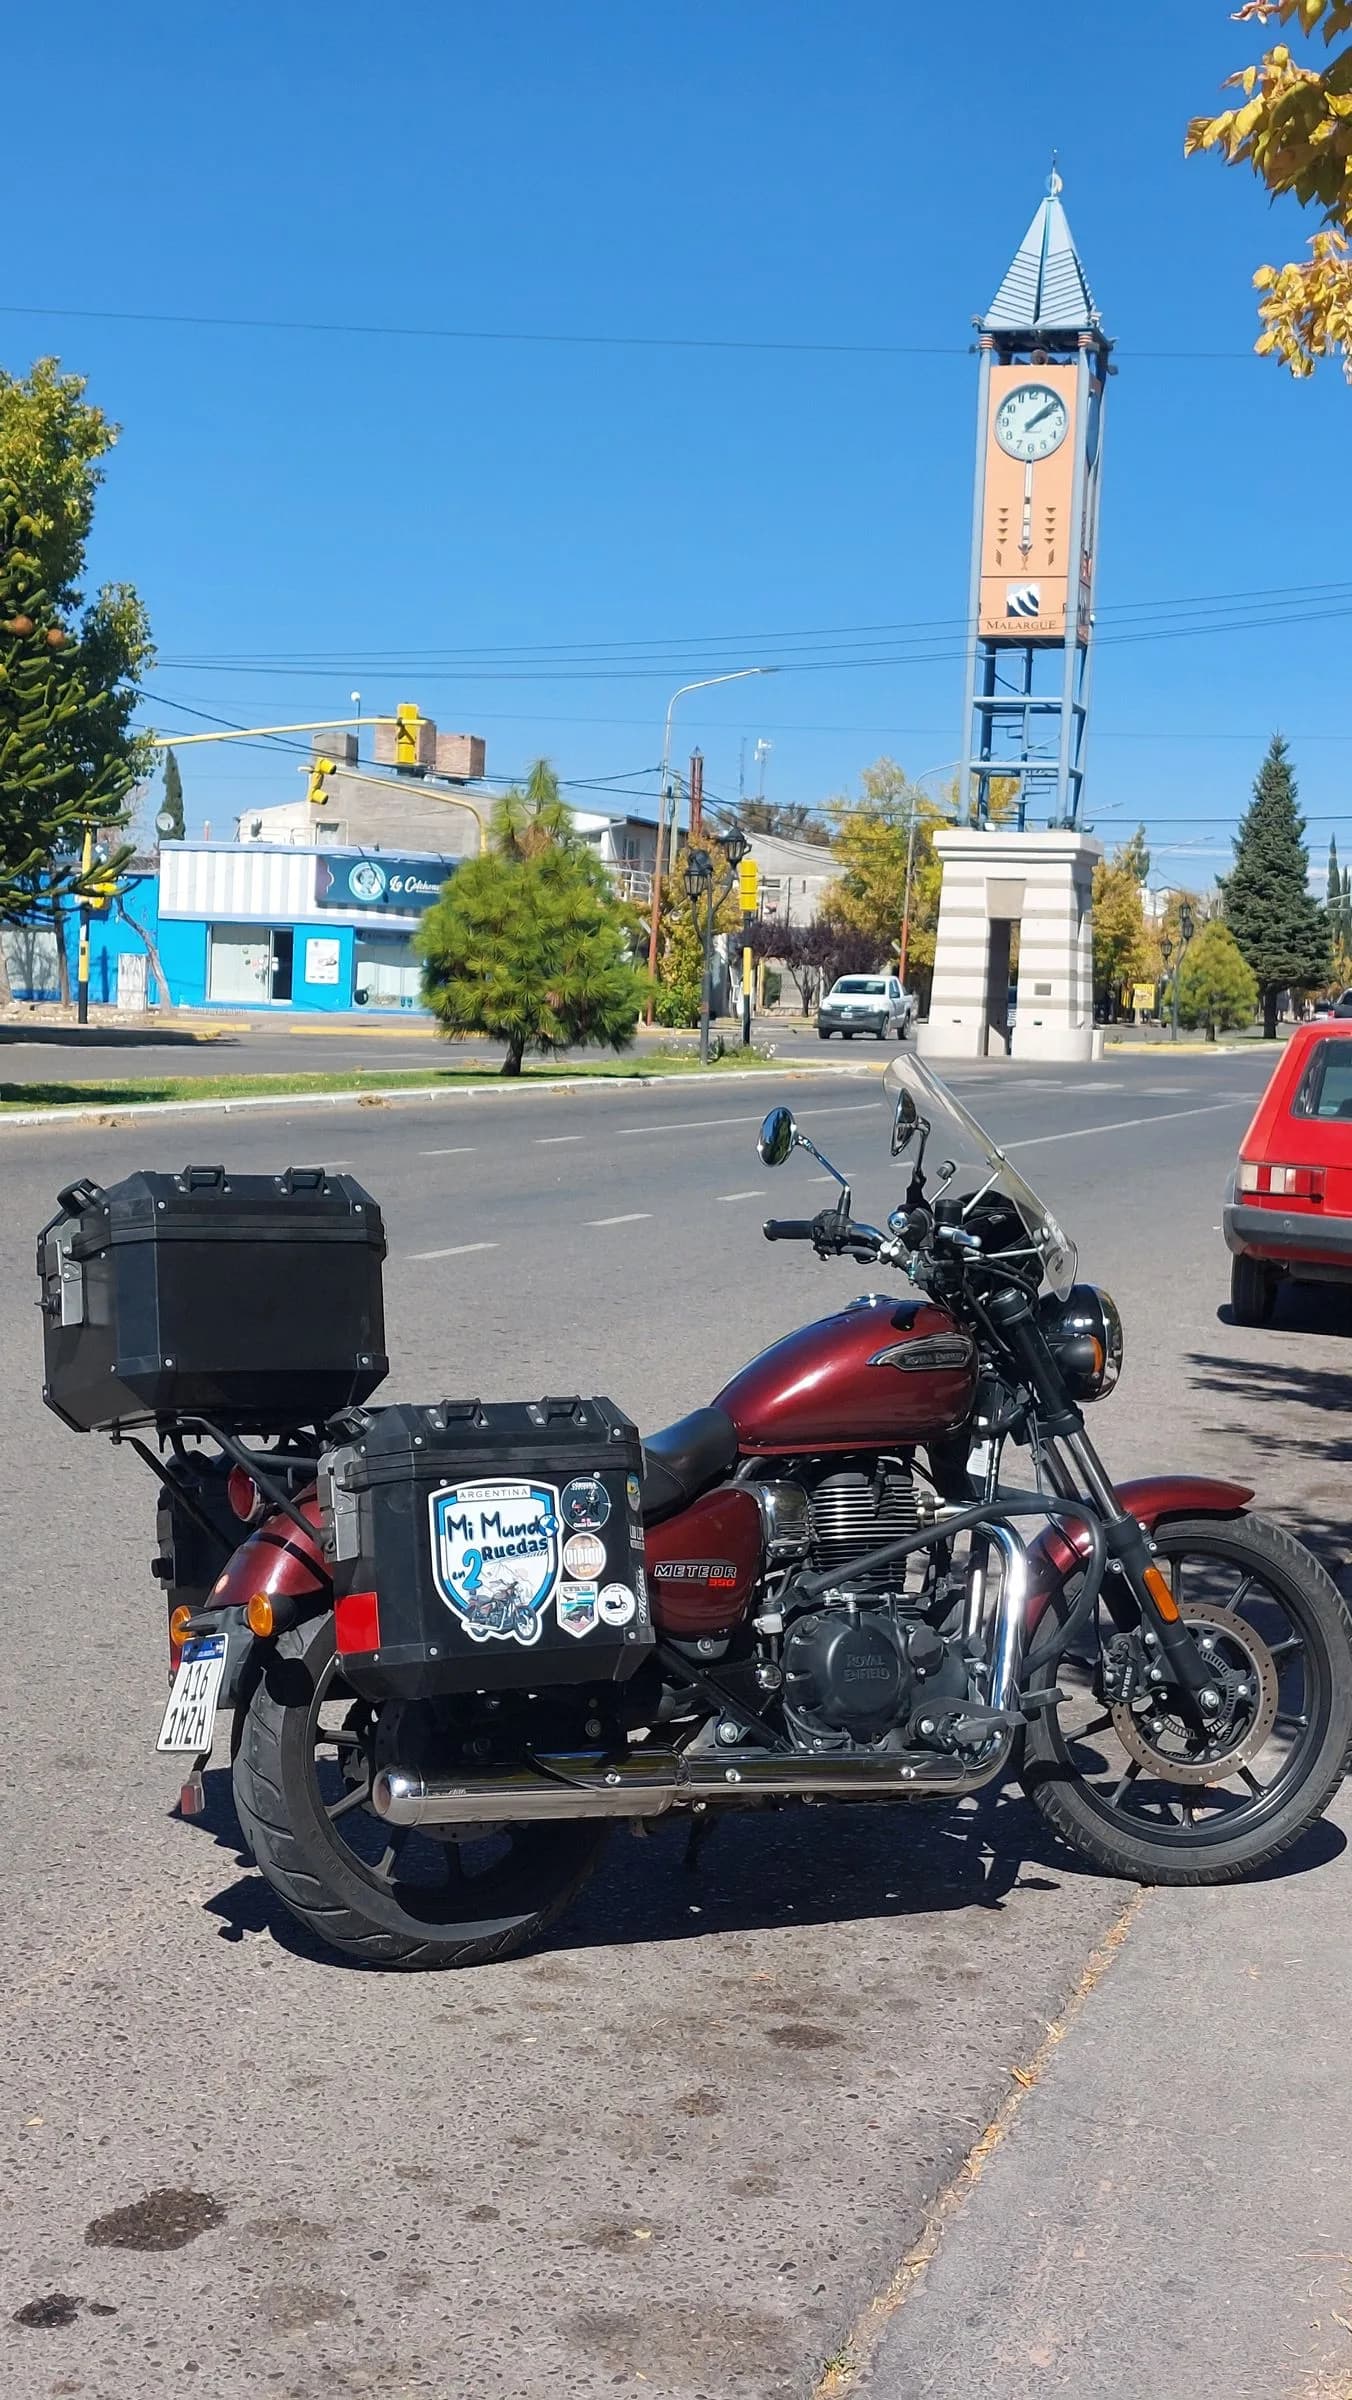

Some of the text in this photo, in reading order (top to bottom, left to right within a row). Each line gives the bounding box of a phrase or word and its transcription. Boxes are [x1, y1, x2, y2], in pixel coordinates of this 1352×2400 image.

[1018, 394, 1025, 403] 11
[1029, 391, 1039, 400] 12
[1007, 404, 1015, 413] 10
[1002, 417, 1009, 427] 9
[1056, 416, 1063, 426] 3
[1006, 430, 1013, 440] 8
[1050, 430, 1056, 439] 4
[1016, 440, 1023, 449] 7
[1027, 443, 1034, 453] 6
[1040, 440, 1047, 449] 5
[459, 1488, 529, 1499] ARGENTINA
[446, 1513, 473, 1542] Mi
[452, 1570, 466, 1580] en
[462, 1549, 482, 1590] 2
[480, 1537, 549, 1562] Ruedas
[653, 1564, 737, 1579] METEOR
[707, 1578, 737, 1588] 350
[180, 1662, 213, 1701] A16
[164, 1705, 207, 1745] 1MZH
